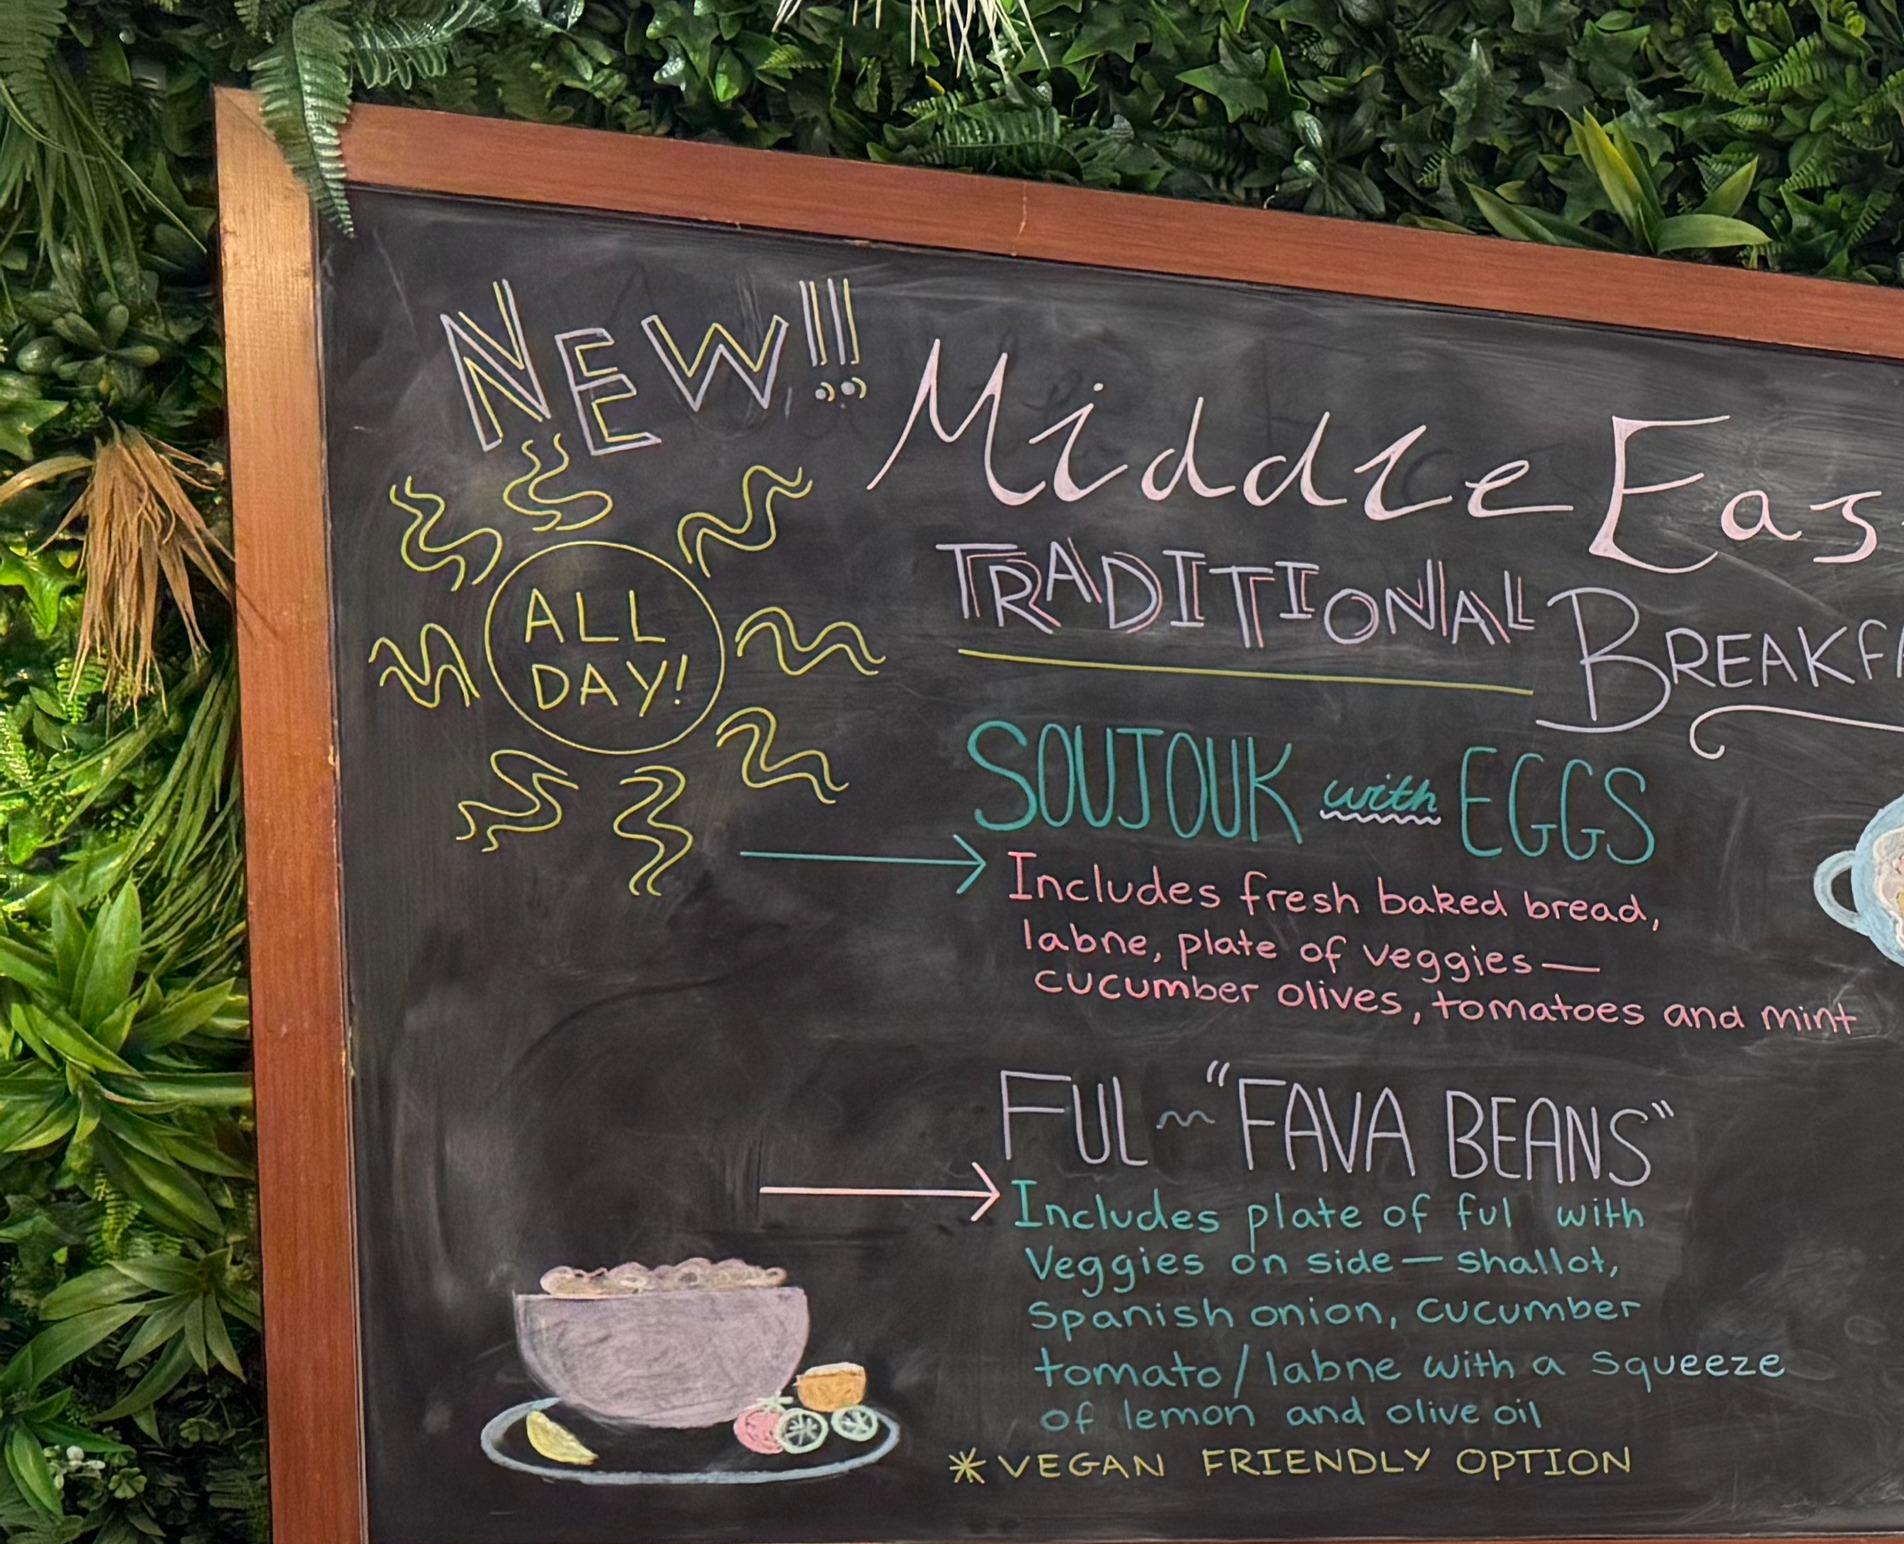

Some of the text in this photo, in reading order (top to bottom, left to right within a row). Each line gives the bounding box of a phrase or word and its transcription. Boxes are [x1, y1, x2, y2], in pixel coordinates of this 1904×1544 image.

[867, 338, 1575, 522] Middle
[524, 587, 667, 644] ALL
[936, 536, 1536, 649] TRADITIONAL
[532, 654, 689, 718] DAY!
[967, 719, 1655, 864] SOUJOUK with EGGS
[1008, 850, 1662, 933] Includes fresh baked bread,
[1023, 920, 1161, 963] labne,
[1179, 930, 1277, 978] plate
[1299, 934, 1350, 969] of
[1034, 969, 1858, 1037] cucumber olives, tomatoes and mint
[1001, 1069, 1148, 1168] FUL
[1013, 1178, 1645, 1253] Includes plate of ful with
[1231, 1249, 1289, 1277] on
[1307, 1242, 1394, 1277] side
[1027, 1295, 1641, 1347] Spanish onion, cucumber
[1422, 1346, 1515, 1380] with
[1532, 1351, 1566, 1376] a
[1041, 1397, 1541, 1435] of lemon and olive oil
[1201, 1446, 1431, 1477] FRIENDLY
[1456, 1446, 1633, 1479] OPTION
